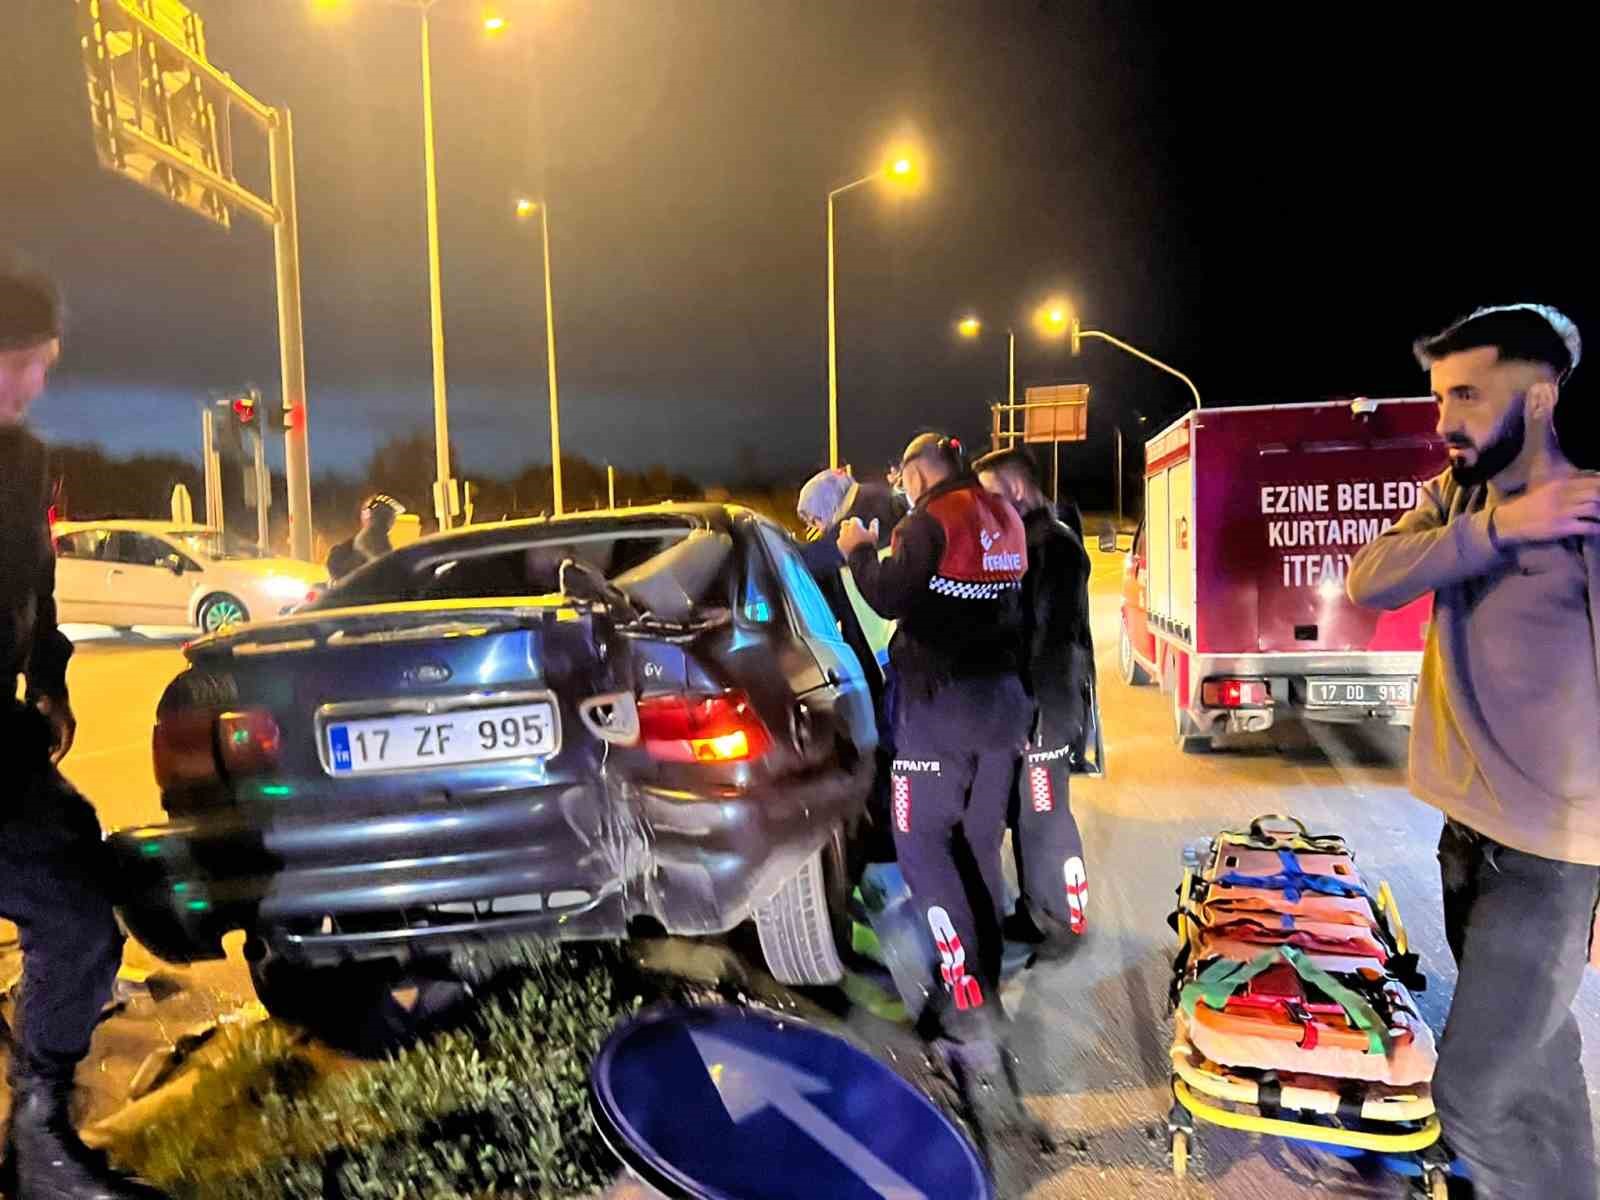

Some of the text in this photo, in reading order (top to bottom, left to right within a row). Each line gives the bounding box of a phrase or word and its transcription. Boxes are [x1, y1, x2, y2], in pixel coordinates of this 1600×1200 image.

[1320, 684, 1408, 701] 17 DD 913
[355, 729, 391, 763] 17
[414, 723, 455, 757] ZF
[477, 714, 543, 751] 995
